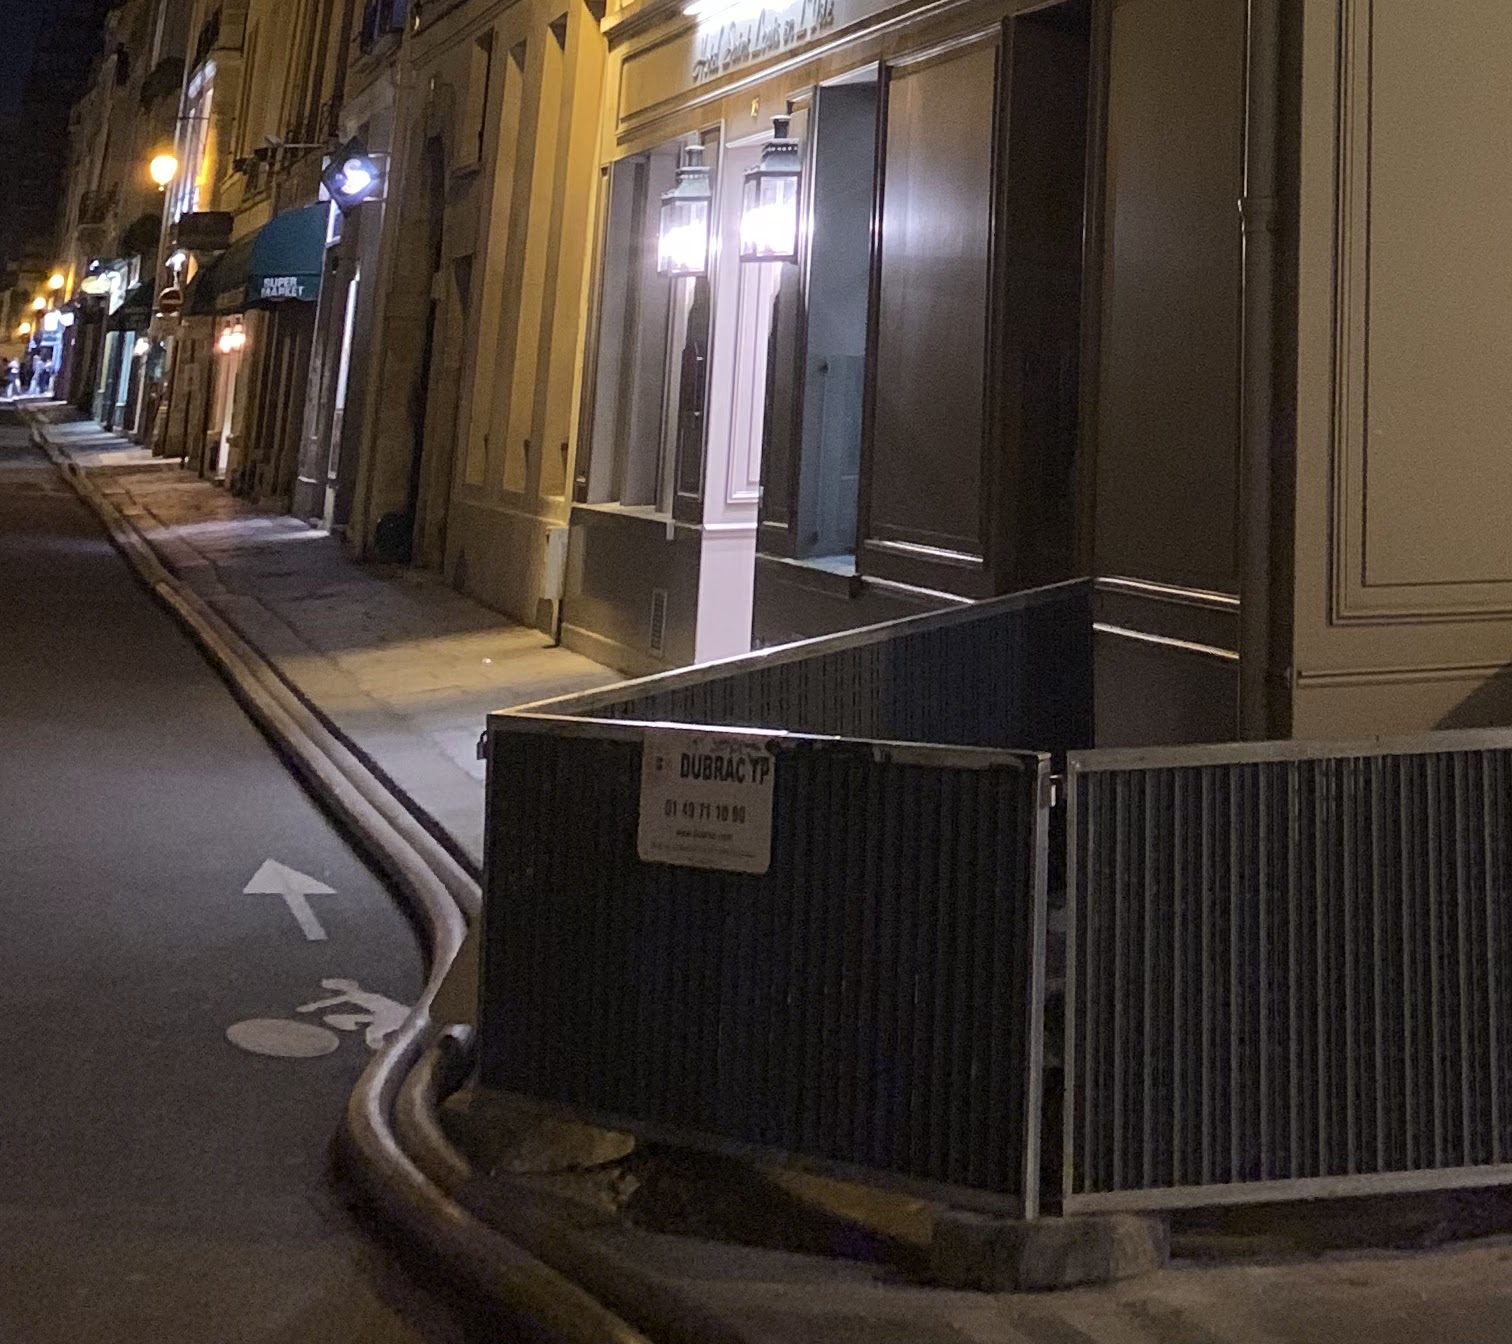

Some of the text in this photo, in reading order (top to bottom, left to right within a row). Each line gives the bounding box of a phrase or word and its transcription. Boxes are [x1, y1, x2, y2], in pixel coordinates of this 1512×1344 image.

[263, 276, 298, 288] SUPER
[261, 286, 305, 298] MARKET
[680, 753, 746, 783] DUBRAC
